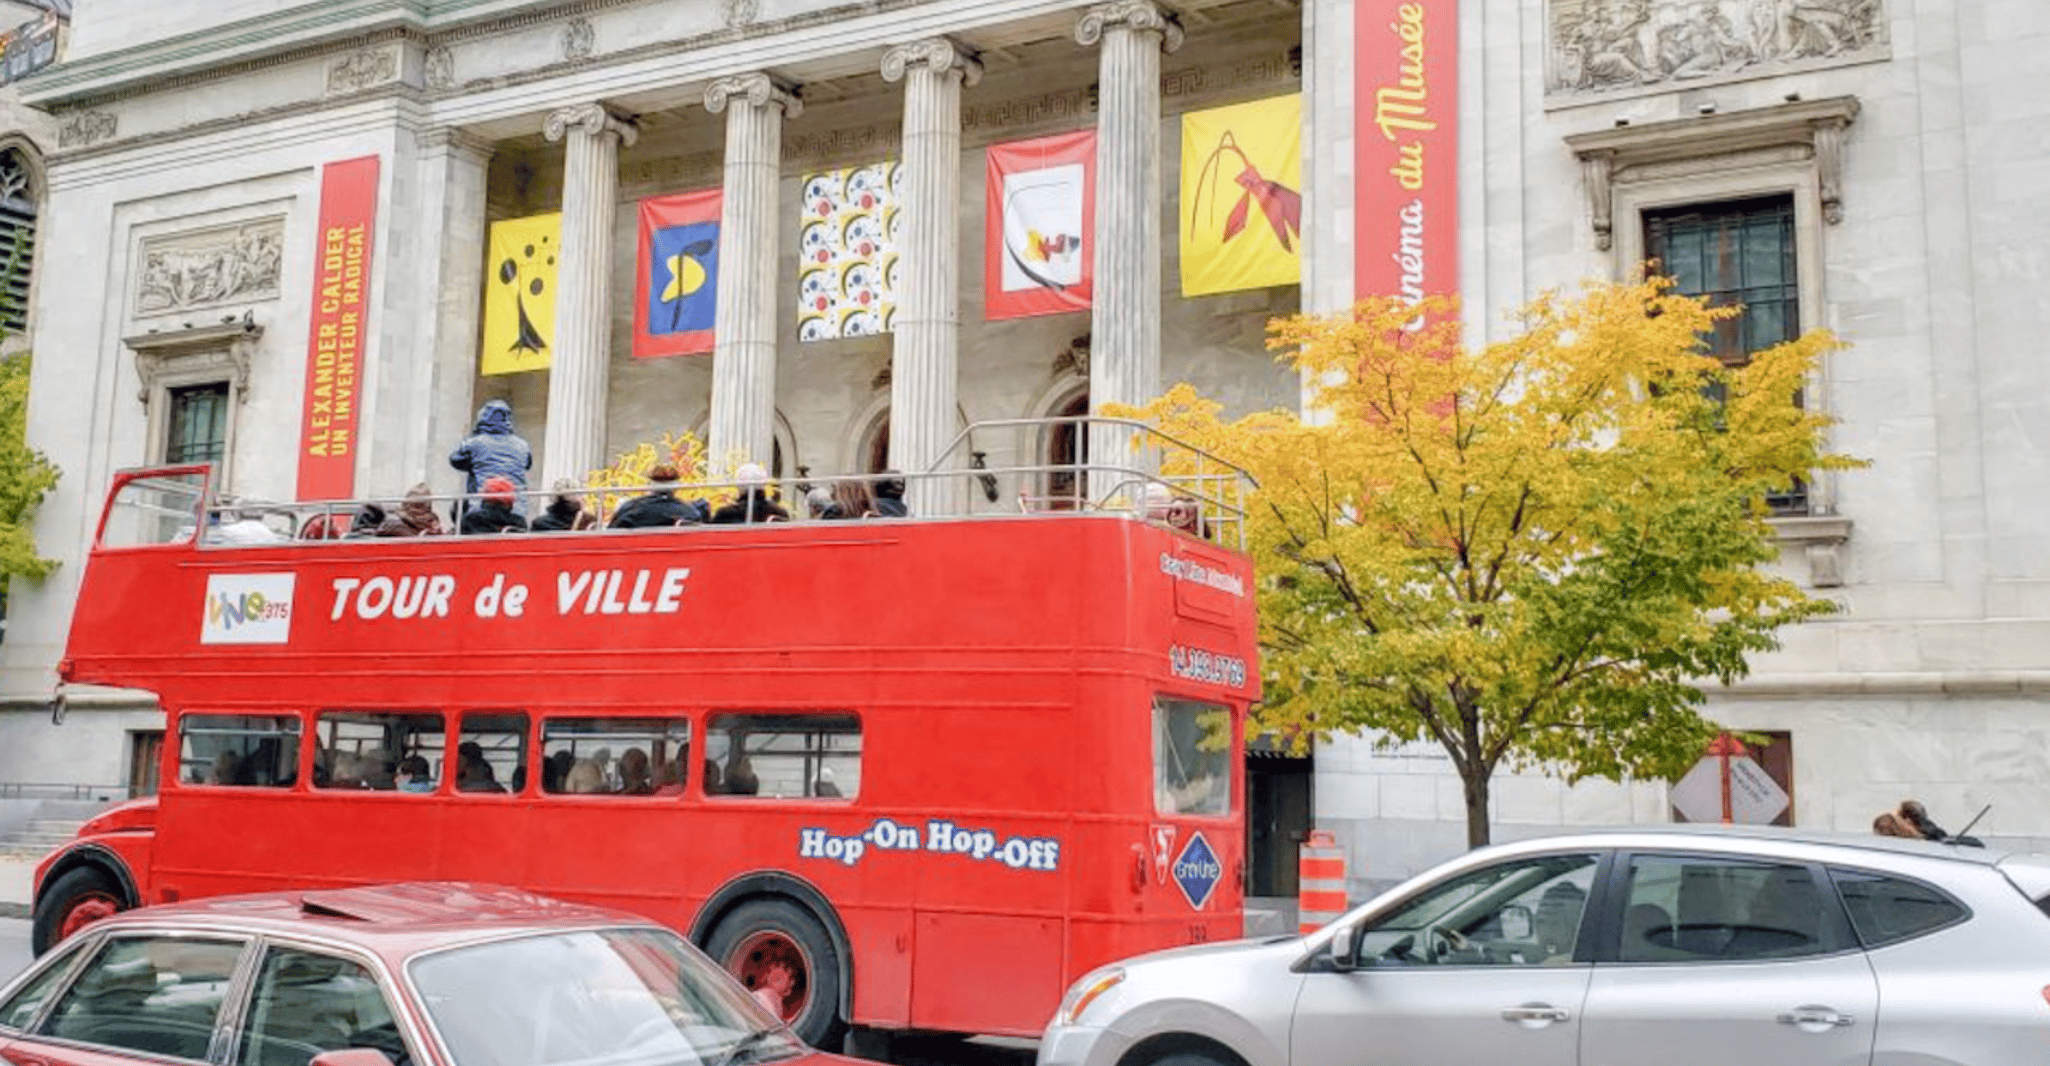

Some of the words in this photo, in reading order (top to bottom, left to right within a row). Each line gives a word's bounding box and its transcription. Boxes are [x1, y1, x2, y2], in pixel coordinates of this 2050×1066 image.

[1375, 2, 1437, 141] Musée
[1390, 140, 1423, 189] du
[321, 227, 345, 313] CALDER
[343, 222, 364, 304] RADICAL
[309, 323, 338, 456] ALEXANDER
[334, 312, 359, 420] INVENTEUR
[331, 429, 349, 456] UN
[331, 574, 456, 621] TOUR
[474, 573, 529, 618] de
[557, 567, 691, 615] VILLE
[799, 818, 920, 866] Hop-On
[926, 820, 1060, 871] Hop-Off
